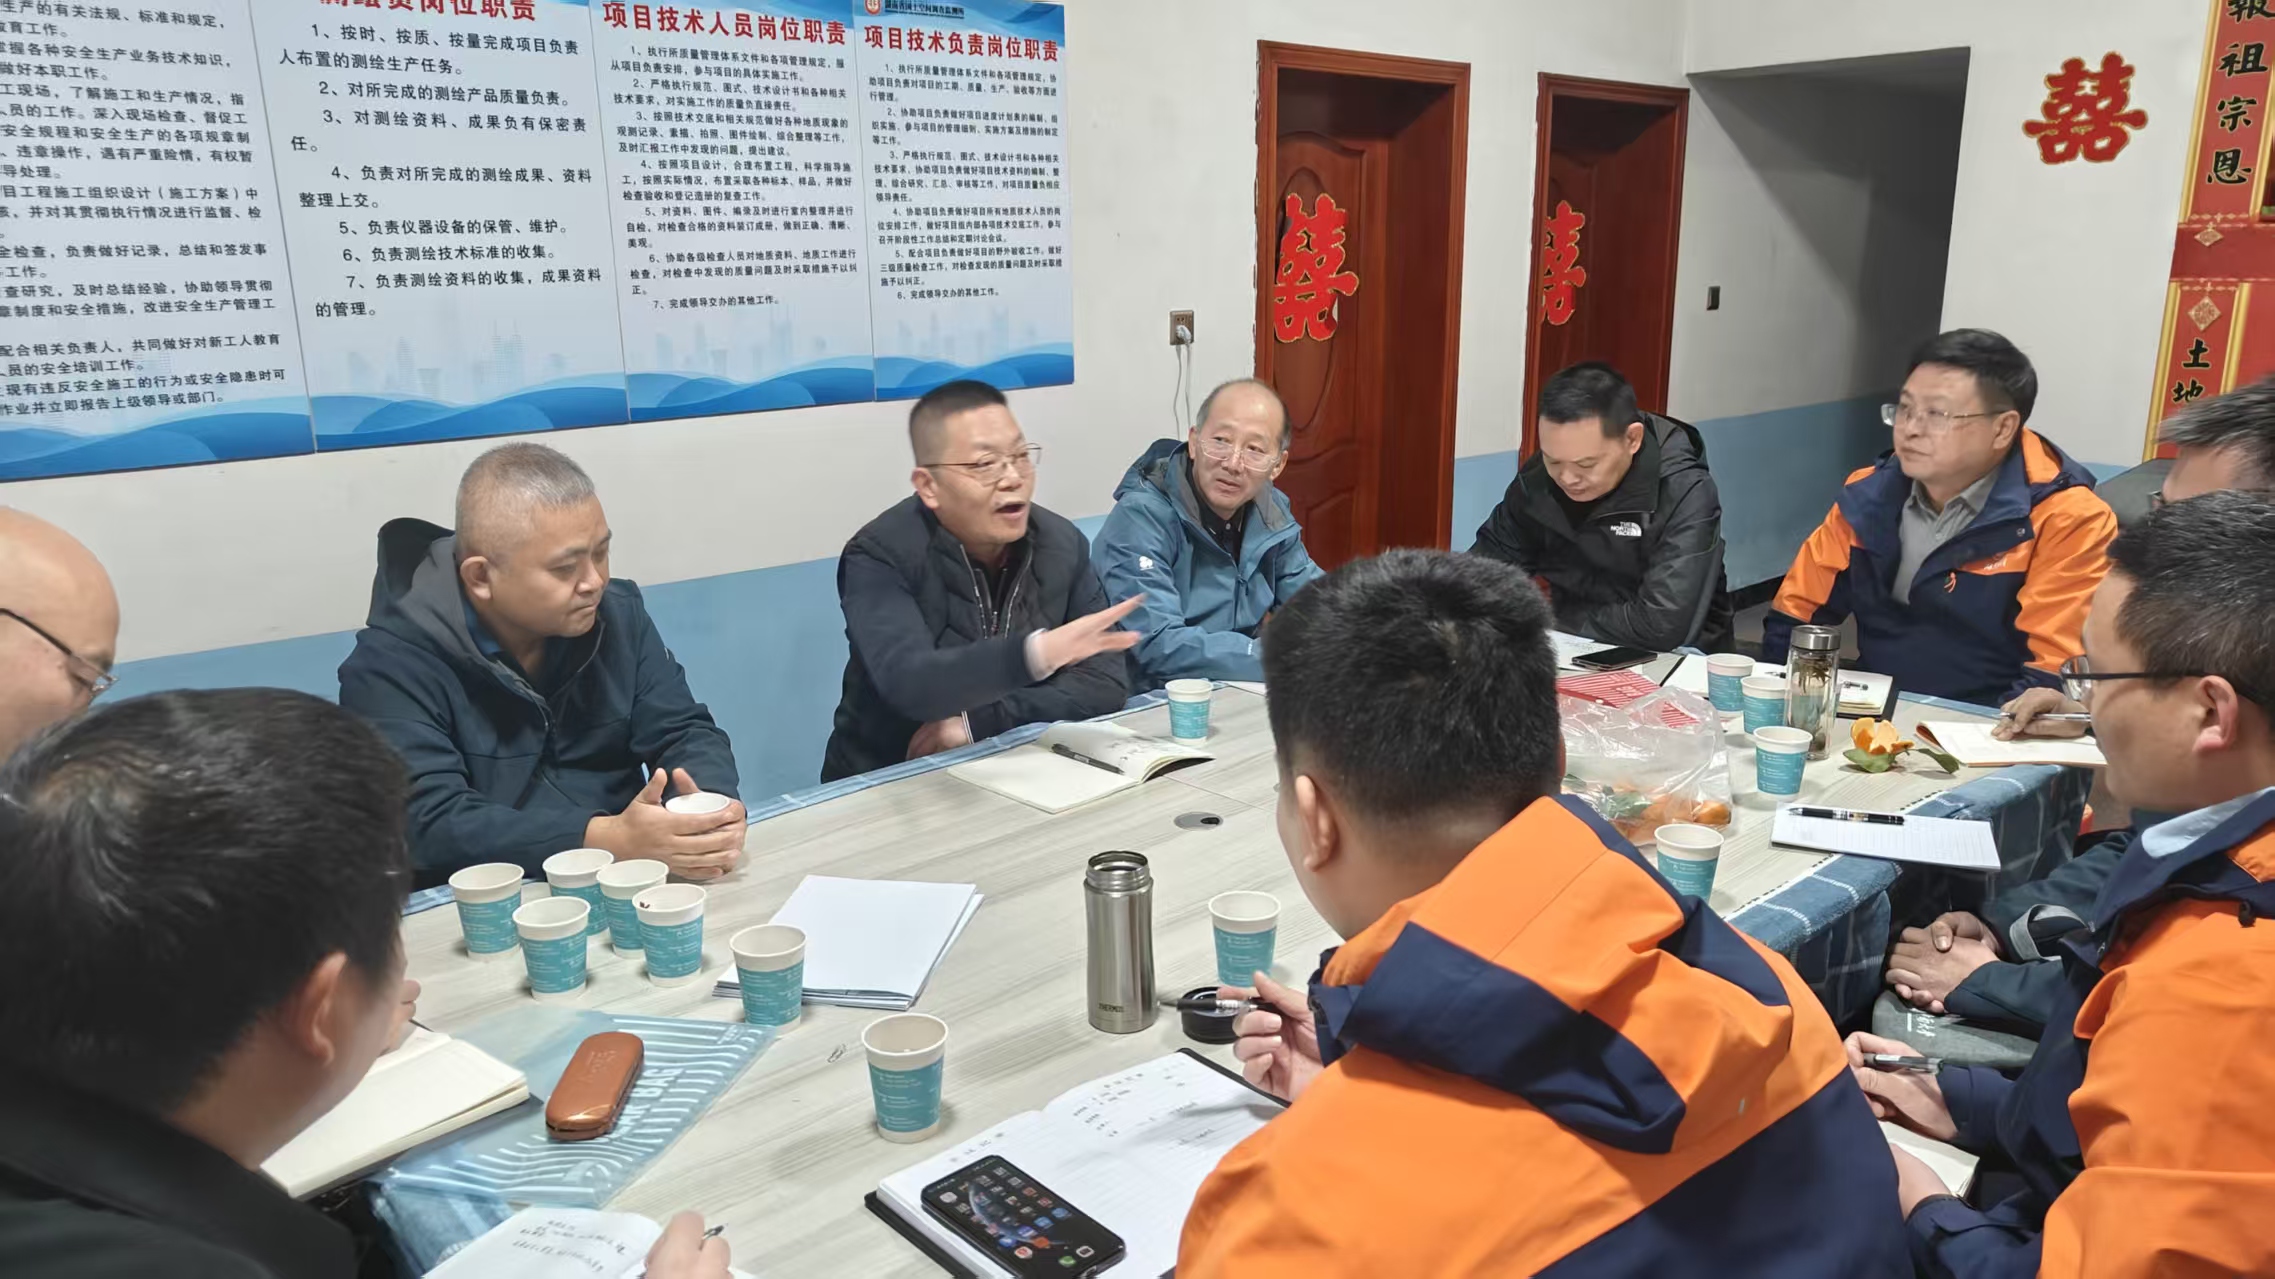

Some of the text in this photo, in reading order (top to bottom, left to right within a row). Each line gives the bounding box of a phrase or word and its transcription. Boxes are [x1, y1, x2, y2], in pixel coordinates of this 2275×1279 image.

[603, 2, 846, 45] 项目技术人员岗位职责
[312, 24, 579, 55] 1、按时、按质、按量完成项目负责
[864, 25, 1059, 62] 项目技术负责岗位职责
[0, 62, 107, 80] 做好本职工作。
[279, 50, 462, 75] 人布置的测绘生产任务。
[319, 81, 568, 106] 2、对所完成的测绘产品质量负责。
[324, 110, 586, 132] 3、对测绘资料、成果负有保密责
[636, 111, 848, 129] 3、按照技术交底和相关规范做好各种地质现象的
[0, 125, 249, 143] 安全规程和安全生产的各项规章制
[291, 136, 318, 152] 任。
[0, 165, 61, 178] 导处理。
[331, 166, 592, 183] 4、负责对所完成的测绘成果、资料
[299, 192, 379, 208] 整理上交。
[339, 219, 566, 236] 5、负责仪器设备的保管、维护。
[628, 238, 653, 249] 美观。
[343, 245, 554, 262] 6、负责测绘技术标准的收集。
[0, 265, 47, 278] 工作。
[346, 268, 602, 289] 7、负责测绘资料的收集，成果资料
[632, 285, 647, 295] 正。
[315, 302, 376, 318] 的管理。
[653, 295, 779, 310] 7、完成领导交办的其他工作。
[0, 369, 285, 396] 现有违反安全施工的行为或安全隐患时可
